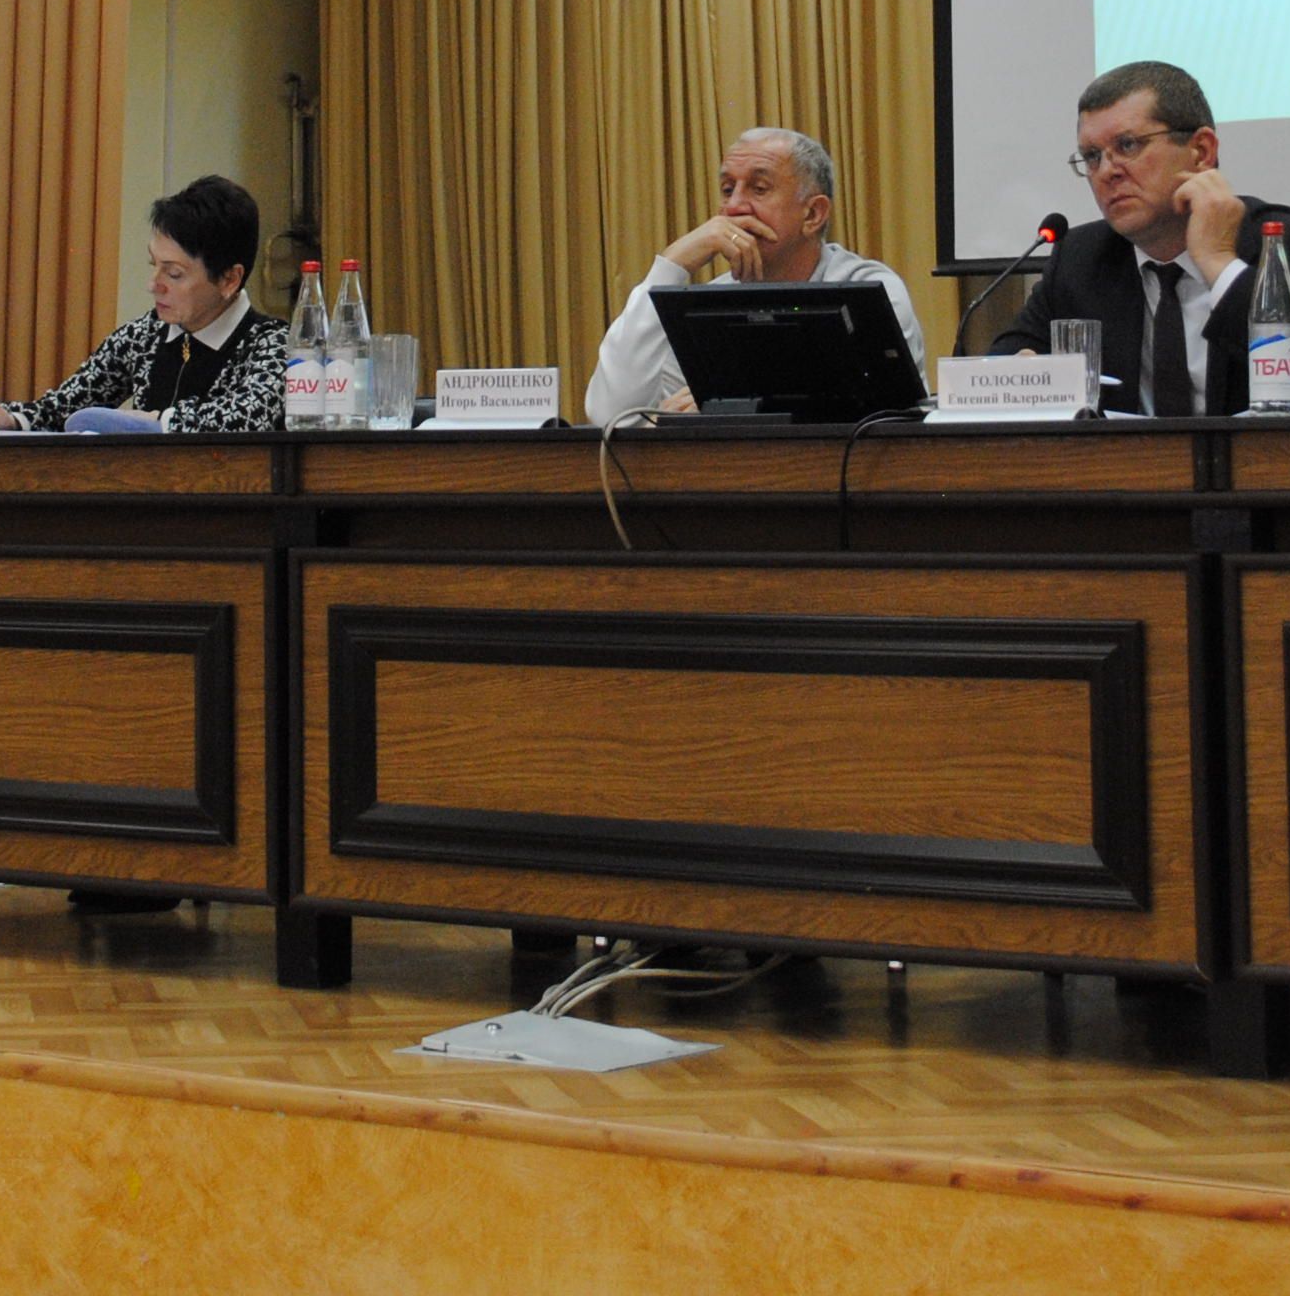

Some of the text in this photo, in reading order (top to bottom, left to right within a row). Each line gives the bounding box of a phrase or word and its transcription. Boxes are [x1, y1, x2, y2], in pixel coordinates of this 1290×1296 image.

[285, 378, 319, 393] БАУ
[441, 373, 553, 390] АНДРЮЩЕНКО
[970, 371, 1052, 388] ГОЛОСНОЙ
[441, 394, 551, 410] Игорь Васильевич
[947, 392, 1075, 406] Евгений Валерьевич
